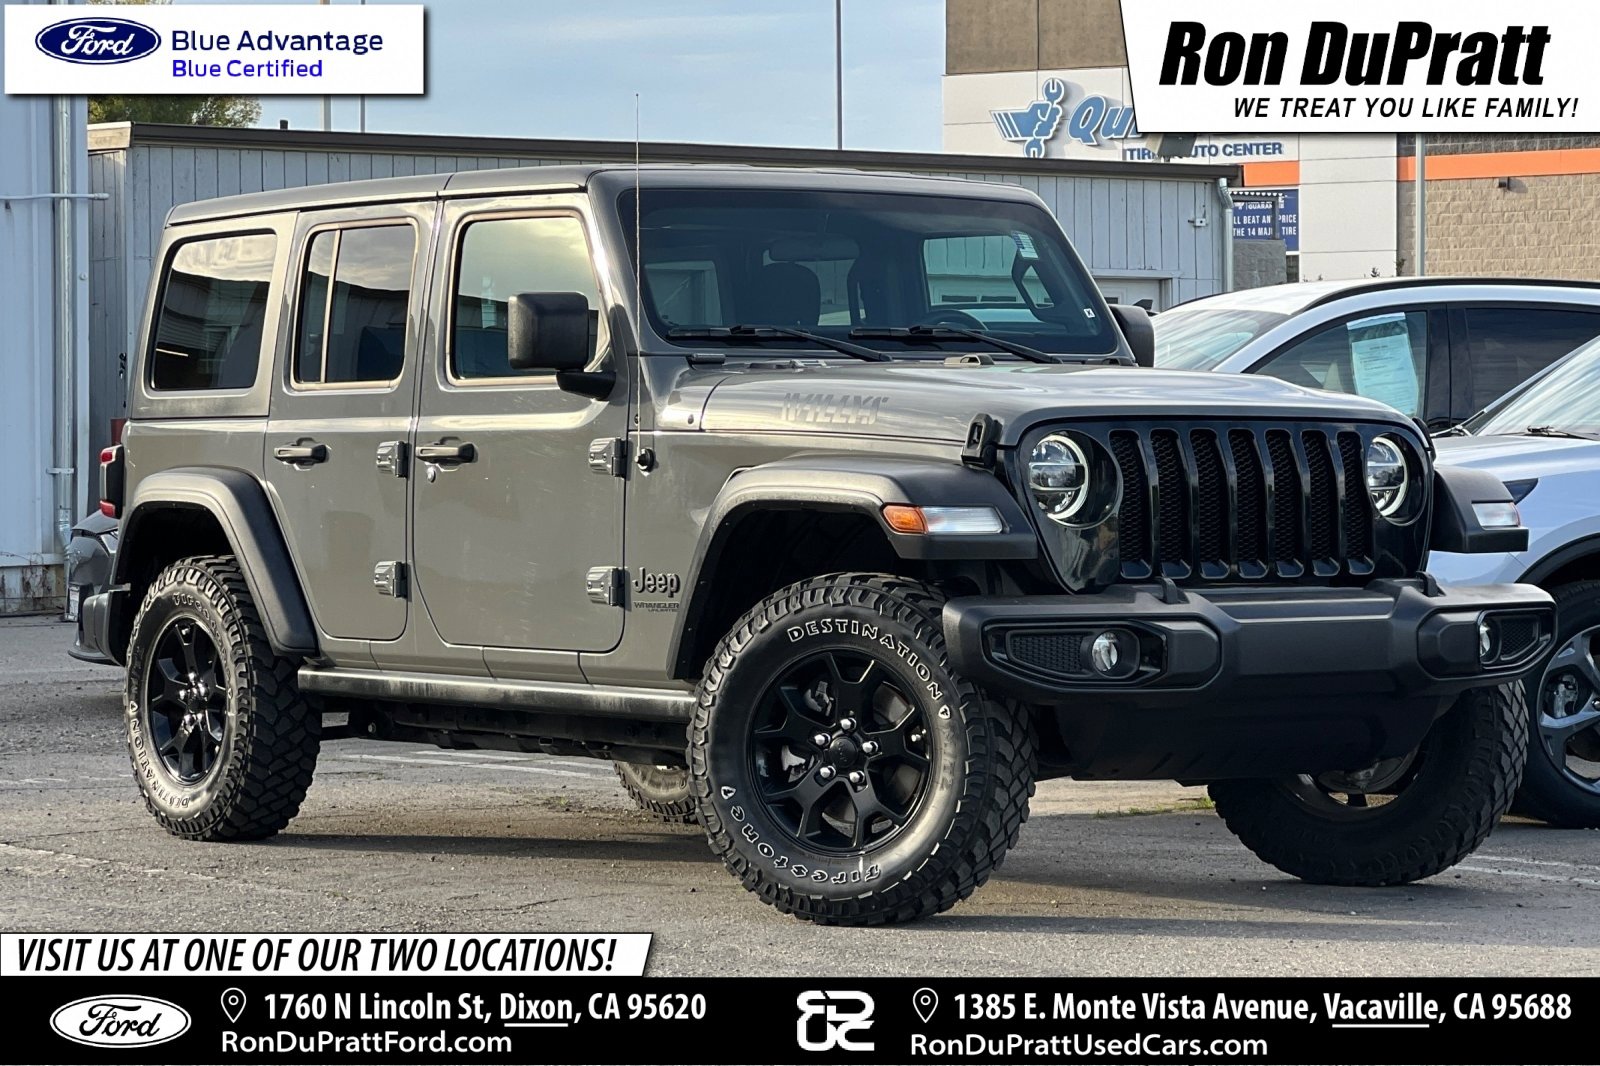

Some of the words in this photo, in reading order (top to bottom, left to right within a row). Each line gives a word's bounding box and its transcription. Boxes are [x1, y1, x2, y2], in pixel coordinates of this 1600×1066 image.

[1222, 142, 1283, 156] CENTER
[1243, 214, 1260, 224] BEAT
[1261, 214, 1273, 224] AN
[1247, 227, 1256, 237] 14
[1281, 226, 1297, 236] TIRE
[632, 567, 681, 598] Jeep
[786, 618, 943, 701] DESTINATION
